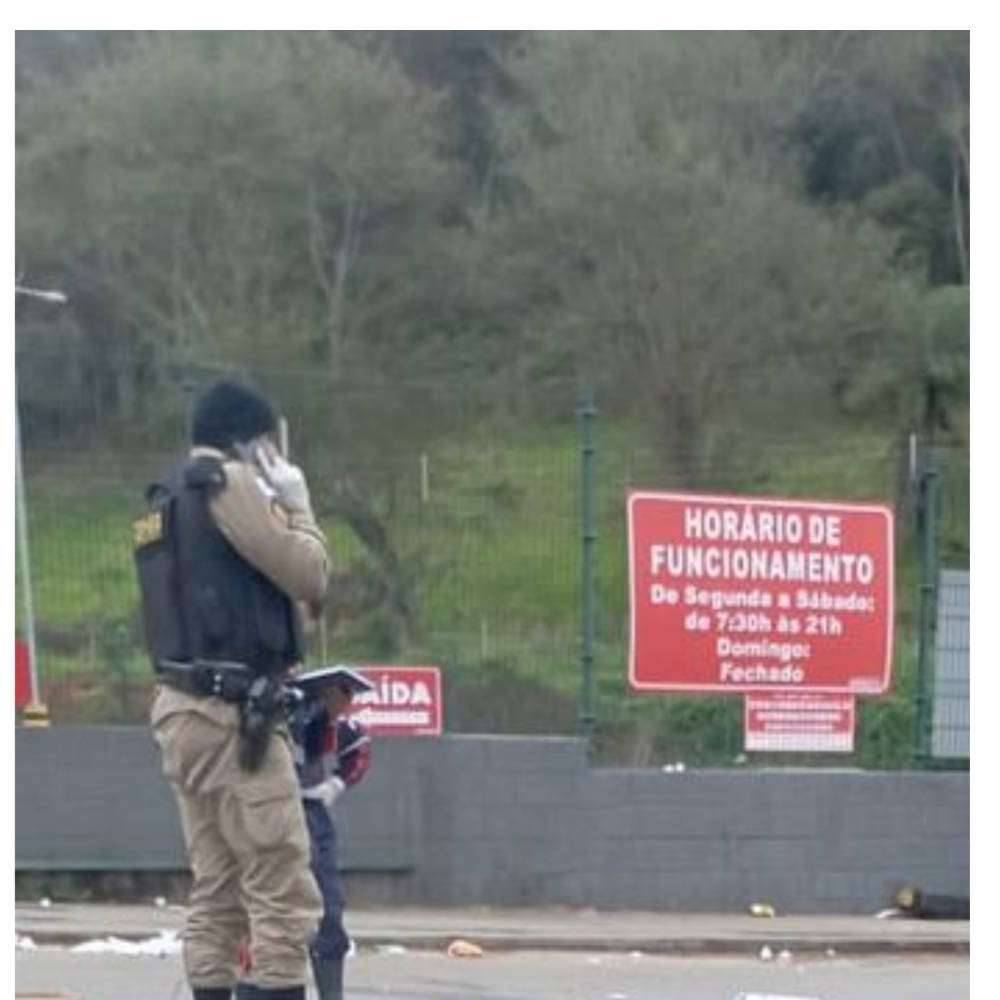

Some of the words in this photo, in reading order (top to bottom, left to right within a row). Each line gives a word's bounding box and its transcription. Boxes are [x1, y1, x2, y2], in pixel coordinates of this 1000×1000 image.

[684, 506, 803, 544] HORÁRIO
[808, 514, 841, 546] DE
[650, 545, 874, 585] FUNCIONAMENTO
[650, 584, 679, 604] De
[684, 586, 771, 609] Segunda
[777, 593, 791, 608] a
[796, 589, 875, 612] Sábado:
[684, 612, 711, 630] de
[716, 612, 771, 632] 7:30h
[777, 615, 800, 633] às
[805, 616, 842, 635] 21h
[716, 637, 811, 661] Domingo:
[720, 662, 804, 682] Fechado
